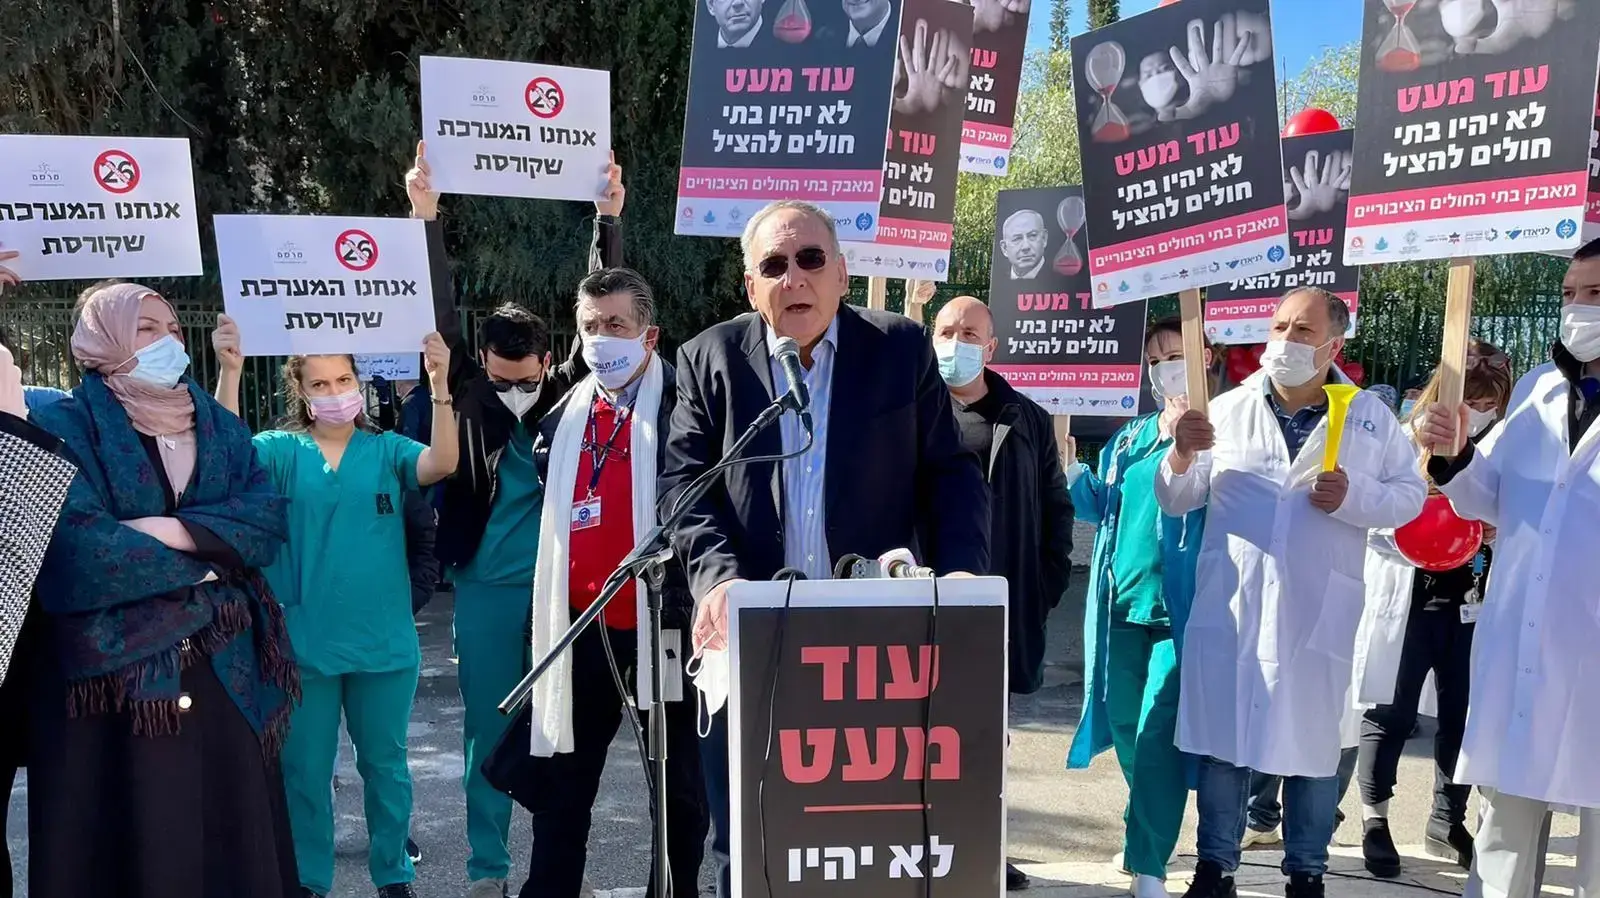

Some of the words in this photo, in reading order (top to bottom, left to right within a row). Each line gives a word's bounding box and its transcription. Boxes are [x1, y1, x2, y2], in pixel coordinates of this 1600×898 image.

[970, 47, 998, 68] עו
[726, 68, 793, 92] מעט
[802, 67, 855, 92] עוד
[970, 73, 995, 92] לא
[1484, 64, 1549, 99] עוד
[1397, 76, 1475, 113] מעט
[722, 105, 763, 124] בתי
[769, 105, 812, 124] יהיו
[818, 99, 852, 124] לא
[1505, 101, 1547, 132] לא
[437, 118, 531, 142] המערכת
[961, 126, 976, 138] בת
[1393, 121, 1441, 146] בתי
[1448, 112, 1499, 139] יהיו
[540, 125, 597, 147] אנחנו
[712, 128, 782, 153] להציל
[787, 129, 855, 154] חולים
[899, 129, 937, 157] עוד
[978, 129, 1008, 143] מאבק
[1187, 122, 1241, 155] עוד
[1114, 139, 1181, 176] מעט
[1383, 143, 1465, 177] להציל
[1470, 136, 1552, 167] חולים
[474, 152, 564, 179] שקורסת
[884, 160, 907, 180] יהי
[910, 161, 933, 184] לא
[1210, 152, 1243, 180] לא
[686, 176, 748, 190] הציבוריים
[752, 175, 800, 191] החולים
[803, 178, 828, 192] בתי
[832, 178, 874, 196] מאבק
[1162, 166, 1204, 193] יהיו
[889, 186, 935, 209] חולים
[1117, 181, 1157, 203] בתי
[1185, 180, 1253, 214] חולים
[1429, 190, 1486, 210] החולים
[1490, 189, 1520, 204] בתי
[1524, 181, 1577, 205] מאבק
[0, 202, 106, 221] המערכת
[115, 202, 181, 220] אנחנו
[1112, 197, 1180, 230] להציל
[1354, 199, 1425, 219] הציבוריים
[877, 226, 898, 237] החו
[900, 228, 917, 240] בתי
[1208, 226, 1233, 241] בתי
[1236, 215, 1280, 237] מאבק
[42, 235, 146, 258] שקורסת
[919, 230, 948, 243] מאבק
[1158, 234, 1204, 254] החולים
[1293, 228, 1334, 247] עוד
[1095, 244, 1155, 268] הציבוריים
[1306, 249, 1333, 267] לא
[240, 279, 346, 297] המערכת
[355, 279, 417, 297] אנחנו
[1229, 272, 1281, 291] להציל
[1285, 269, 1336, 287] חולים
[1017, 292, 1070, 311] מעט
[1210, 305, 1257, 315] הציבוריים
[284, 311, 384, 334] שקורסת
[1015, 319, 1047, 334] בתי
[1051, 319, 1085, 334] יהיו
[1089, 315, 1116, 334] לא
[1008, 336, 1062, 354] להציל
[1066, 336, 1119, 354] חולים
[1039, 369, 1076, 381] החולים
[1079, 371, 1098, 382] בתי
[1101, 371, 1135, 384] מאבק
[801, 644, 940, 701] עוד
[779, 725, 961, 784] מעט
[788, 845, 874, 882] יהיו
[888, 835, 955, 879] לא
